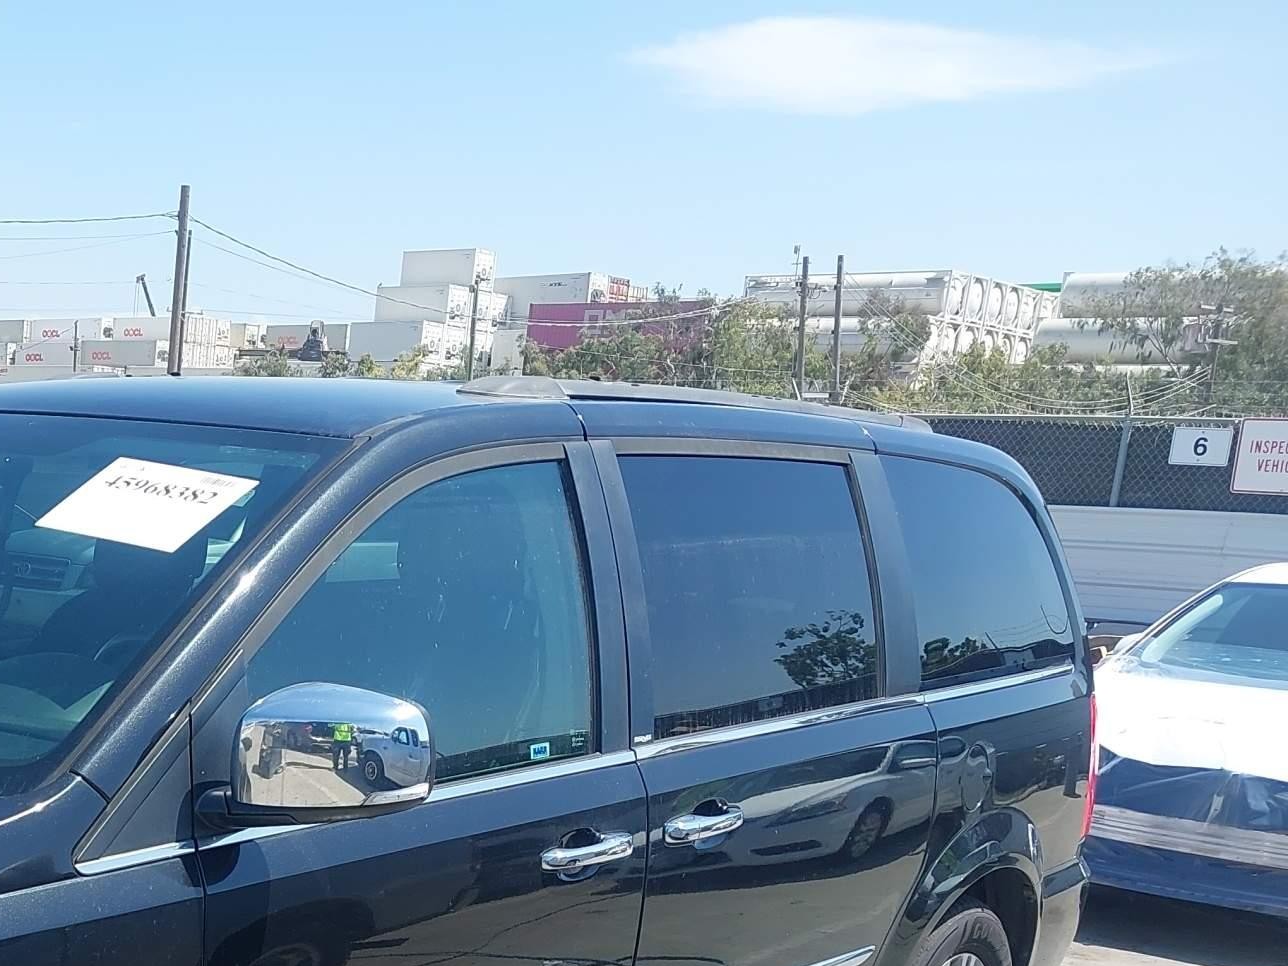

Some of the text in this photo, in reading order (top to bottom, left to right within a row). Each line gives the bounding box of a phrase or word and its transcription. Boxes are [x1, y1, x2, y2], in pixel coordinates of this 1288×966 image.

[42, 329, 60, 338] OOCL
[124, 328, 144, 337] OOCL
[25, 352, 44, 362] OOCL
[91, 351, 112, 361] OOCL
[1193, 437, 1208, 456] 6
[105, 475, 218, 505] 45968382
